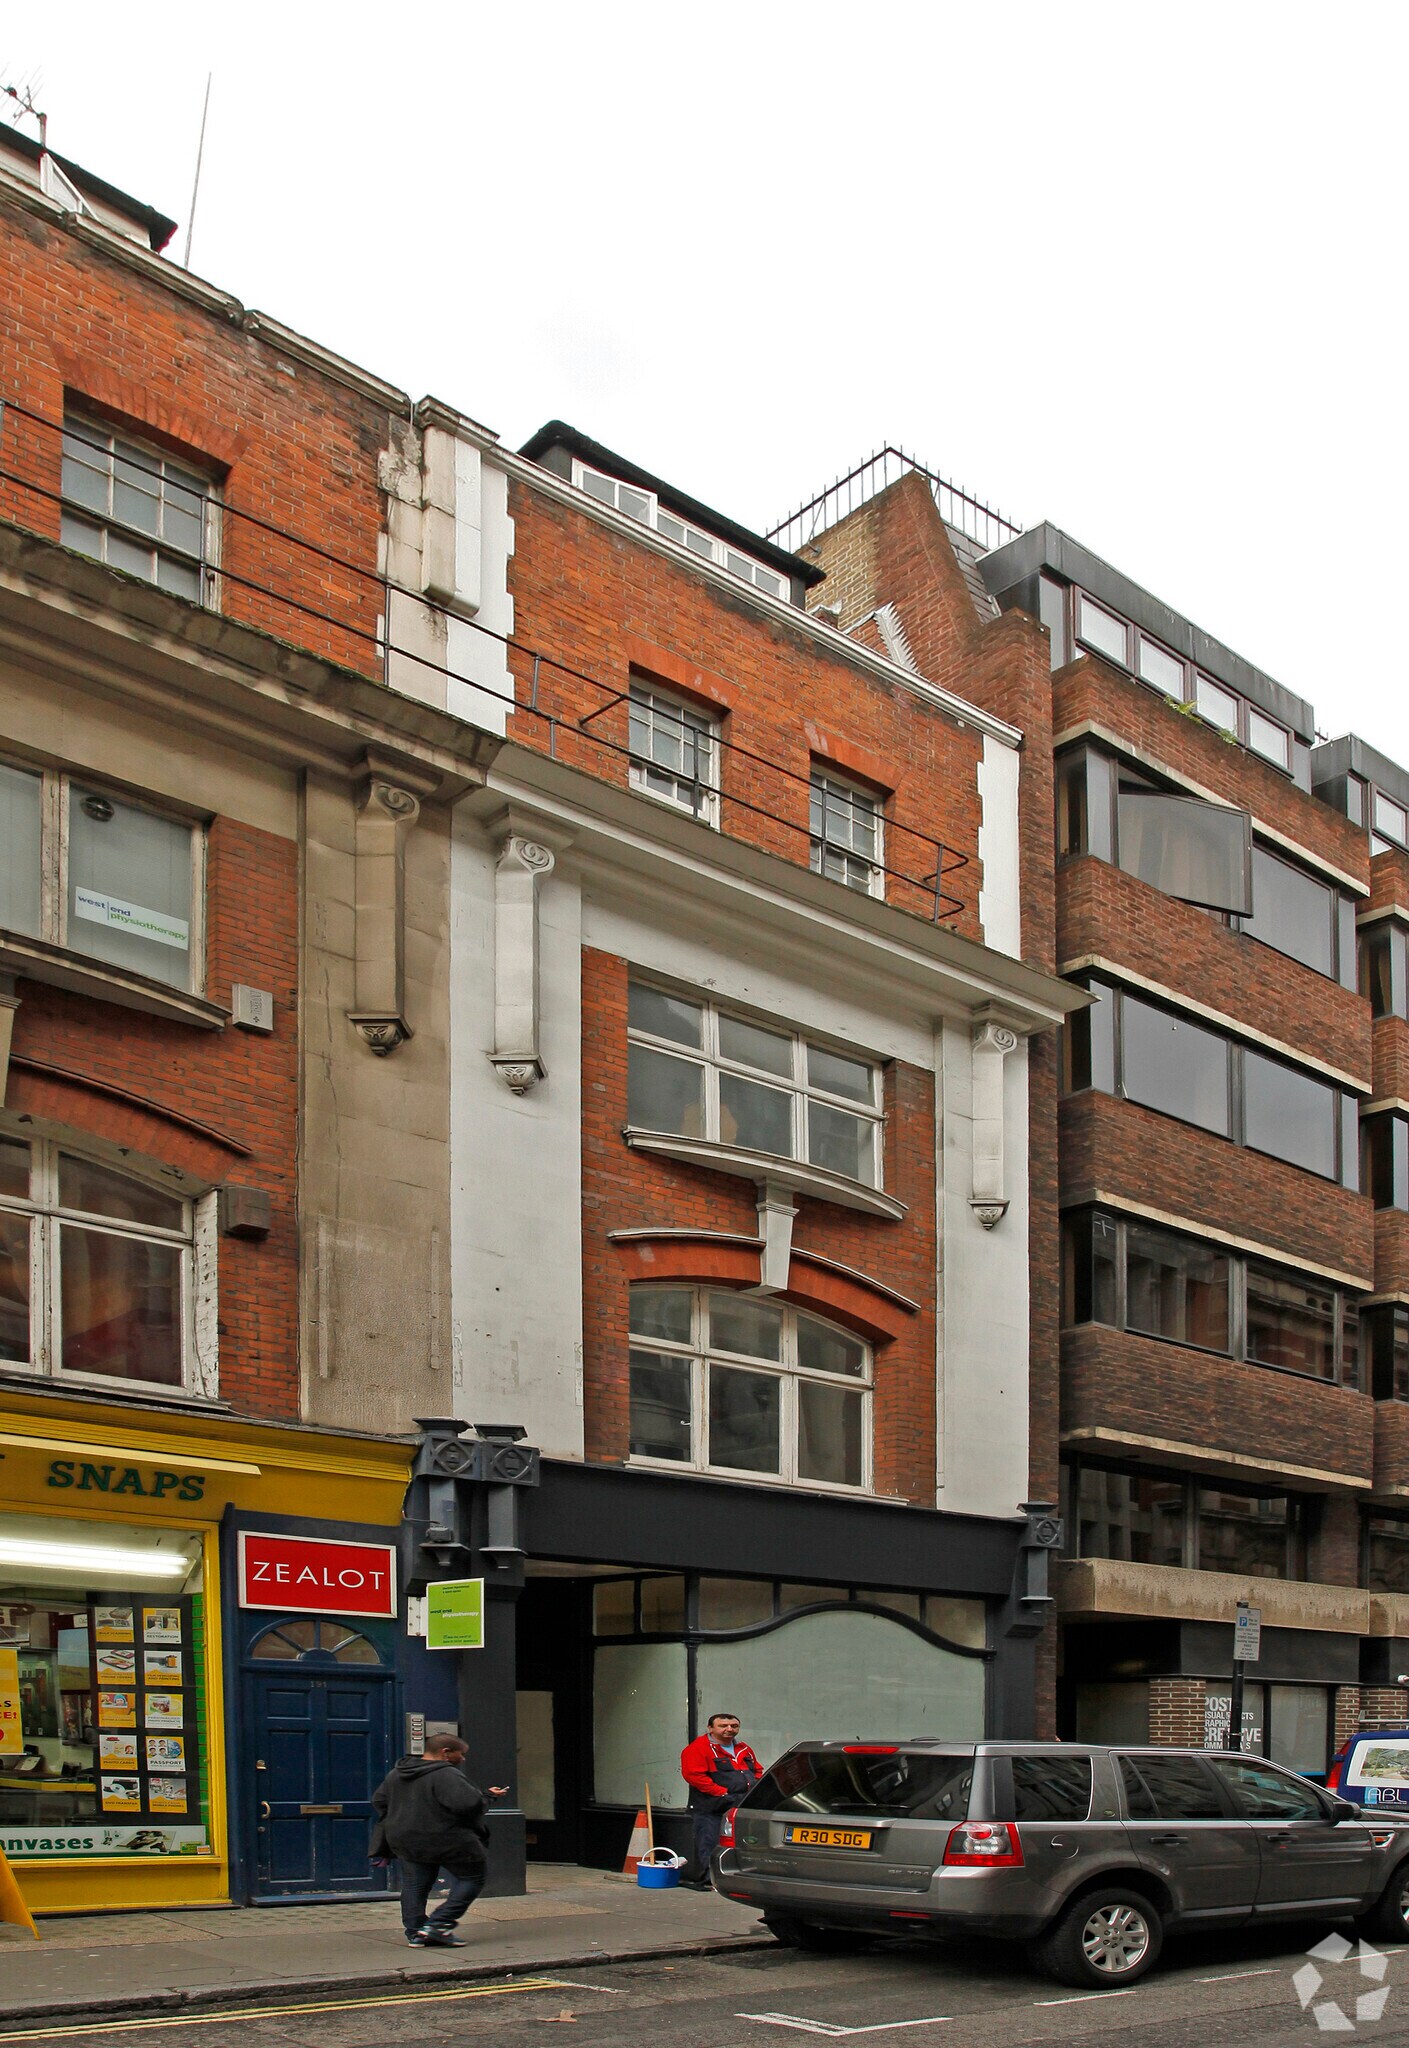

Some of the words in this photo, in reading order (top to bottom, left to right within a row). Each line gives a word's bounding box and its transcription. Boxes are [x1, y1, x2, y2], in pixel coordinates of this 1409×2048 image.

[78, 895, 106, 910] west
[110, 905, 131, 917] end
[110, 912, 187, 941] physiotherapy
[48, 1460, 206, 1501] SNAPS
[252, 1561, 385, 1590] ZEALOT
[1205, 1711, 1225, 1720] ISUAL
[1367, 1787, 1407, 1802] ABL
[799, 1830, 829, 1844] R30
[832, 1833, 863, 1846] SDG
